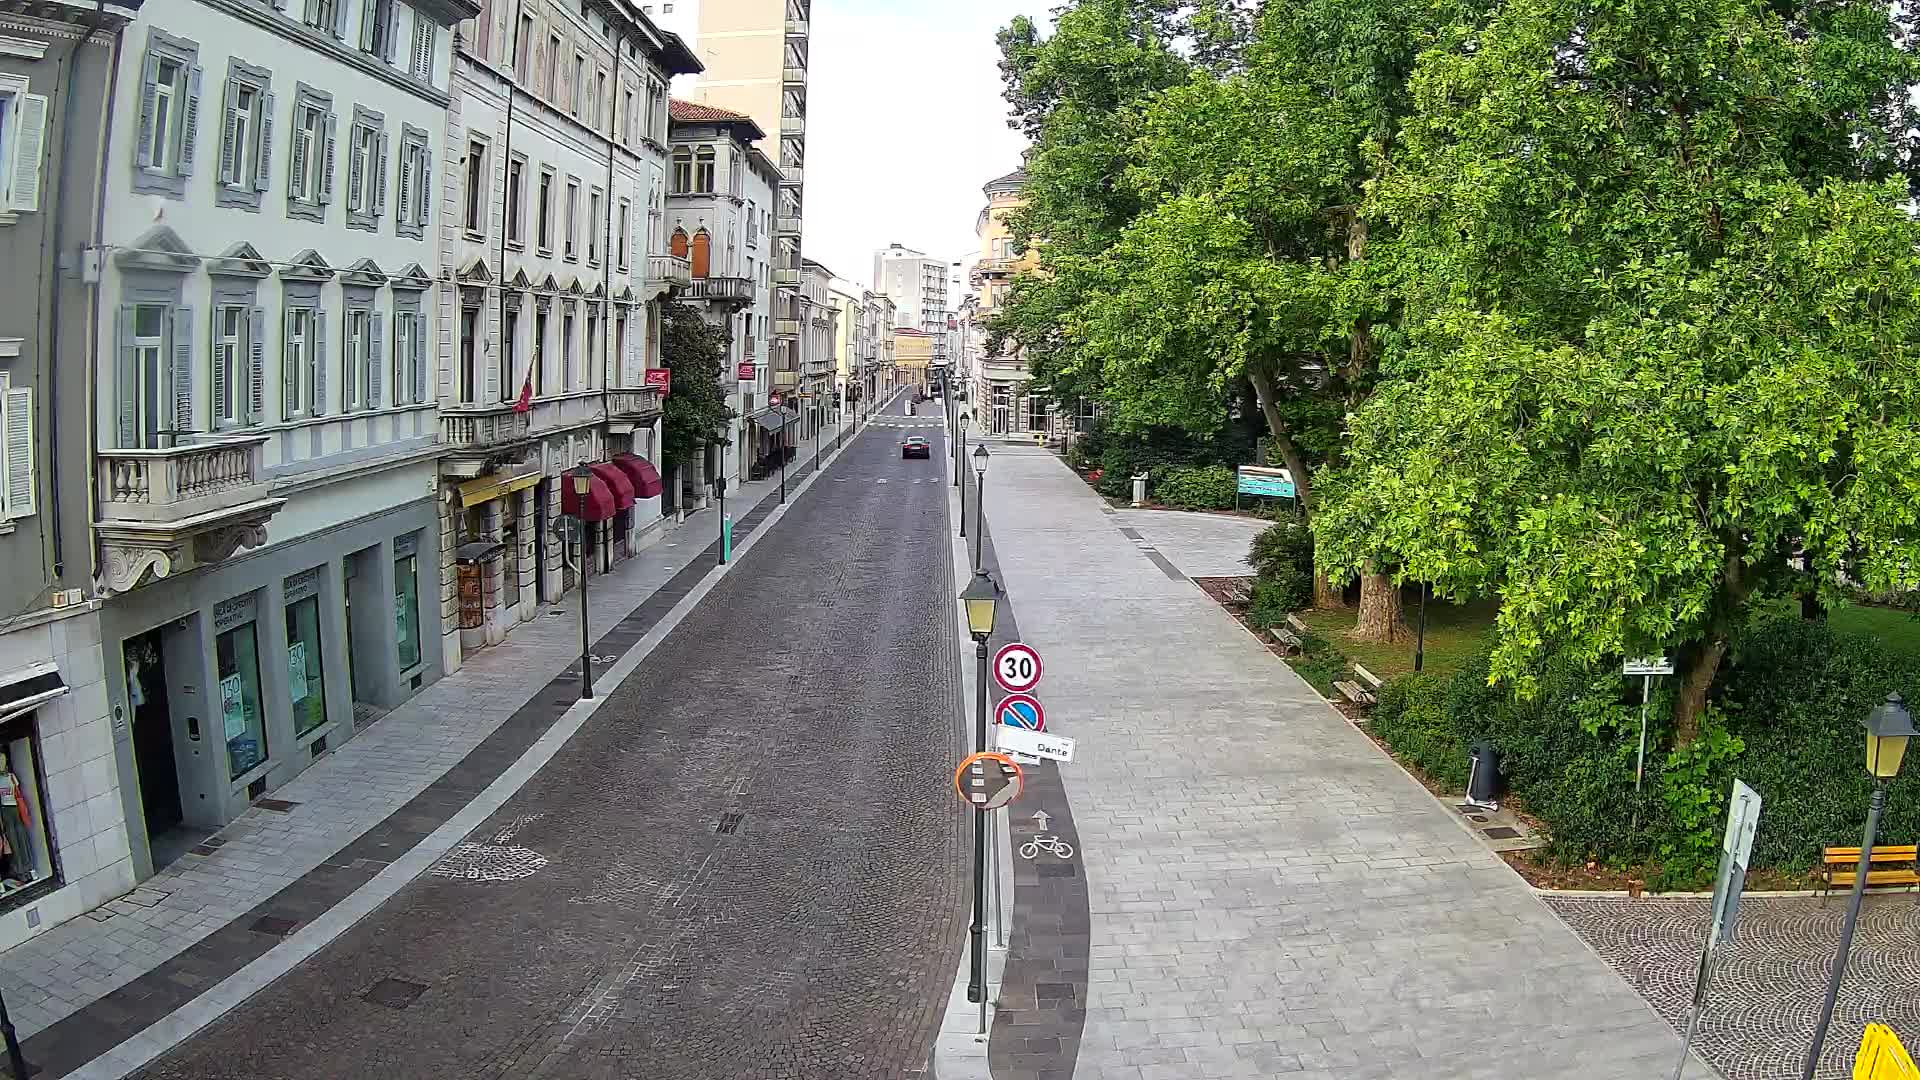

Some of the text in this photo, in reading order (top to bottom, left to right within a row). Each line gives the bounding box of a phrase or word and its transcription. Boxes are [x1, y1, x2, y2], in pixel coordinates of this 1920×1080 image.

[1004, 657, 1031, 679] 30
[222, 676, 240, 699] 130
[1037, 743, 1068, 756] Dante
